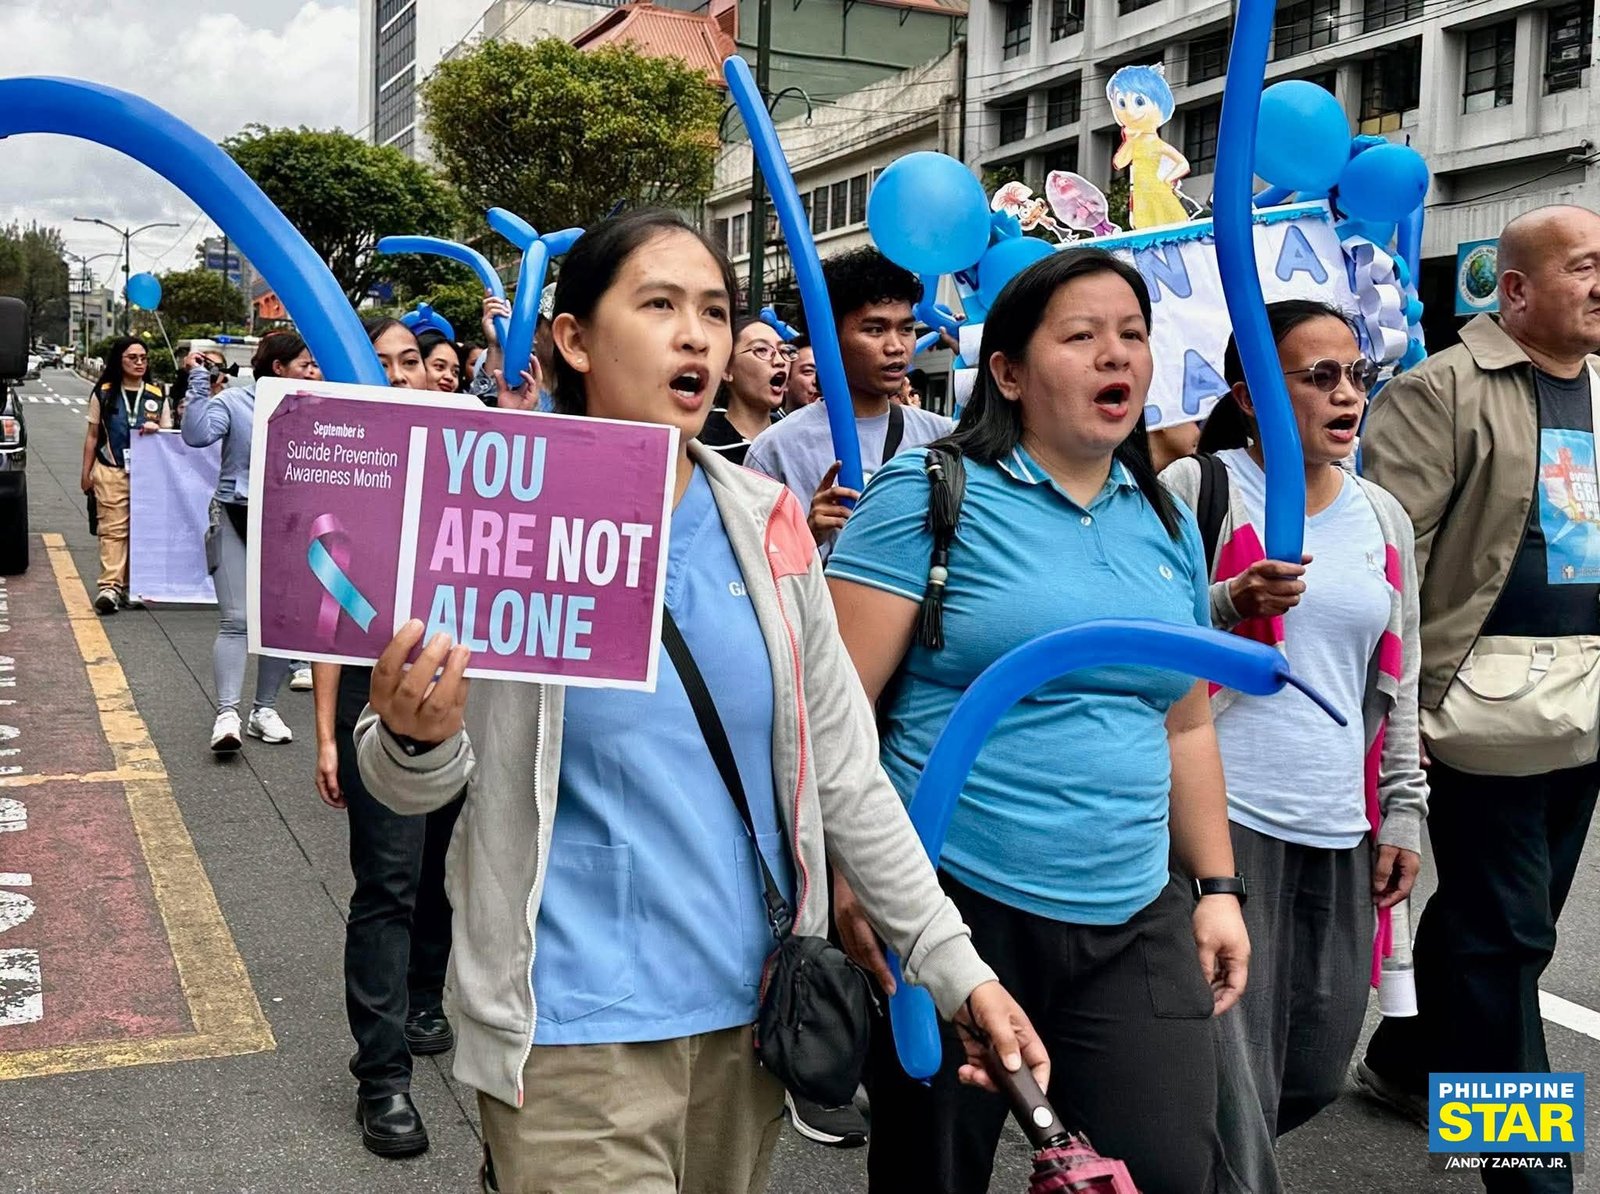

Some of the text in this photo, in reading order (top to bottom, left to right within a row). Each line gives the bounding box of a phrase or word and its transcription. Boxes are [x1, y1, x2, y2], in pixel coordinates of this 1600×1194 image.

[287, 440, 398, 467] Suicide Prevention
[313, 421, 365, 439] September is
[284, 462, 392, 489] Awareness Month
[441, 427, 547, 502] YOU
[429, 506, 653, 589] ARE NOT
[423, 584, 596, 661] ALONE
